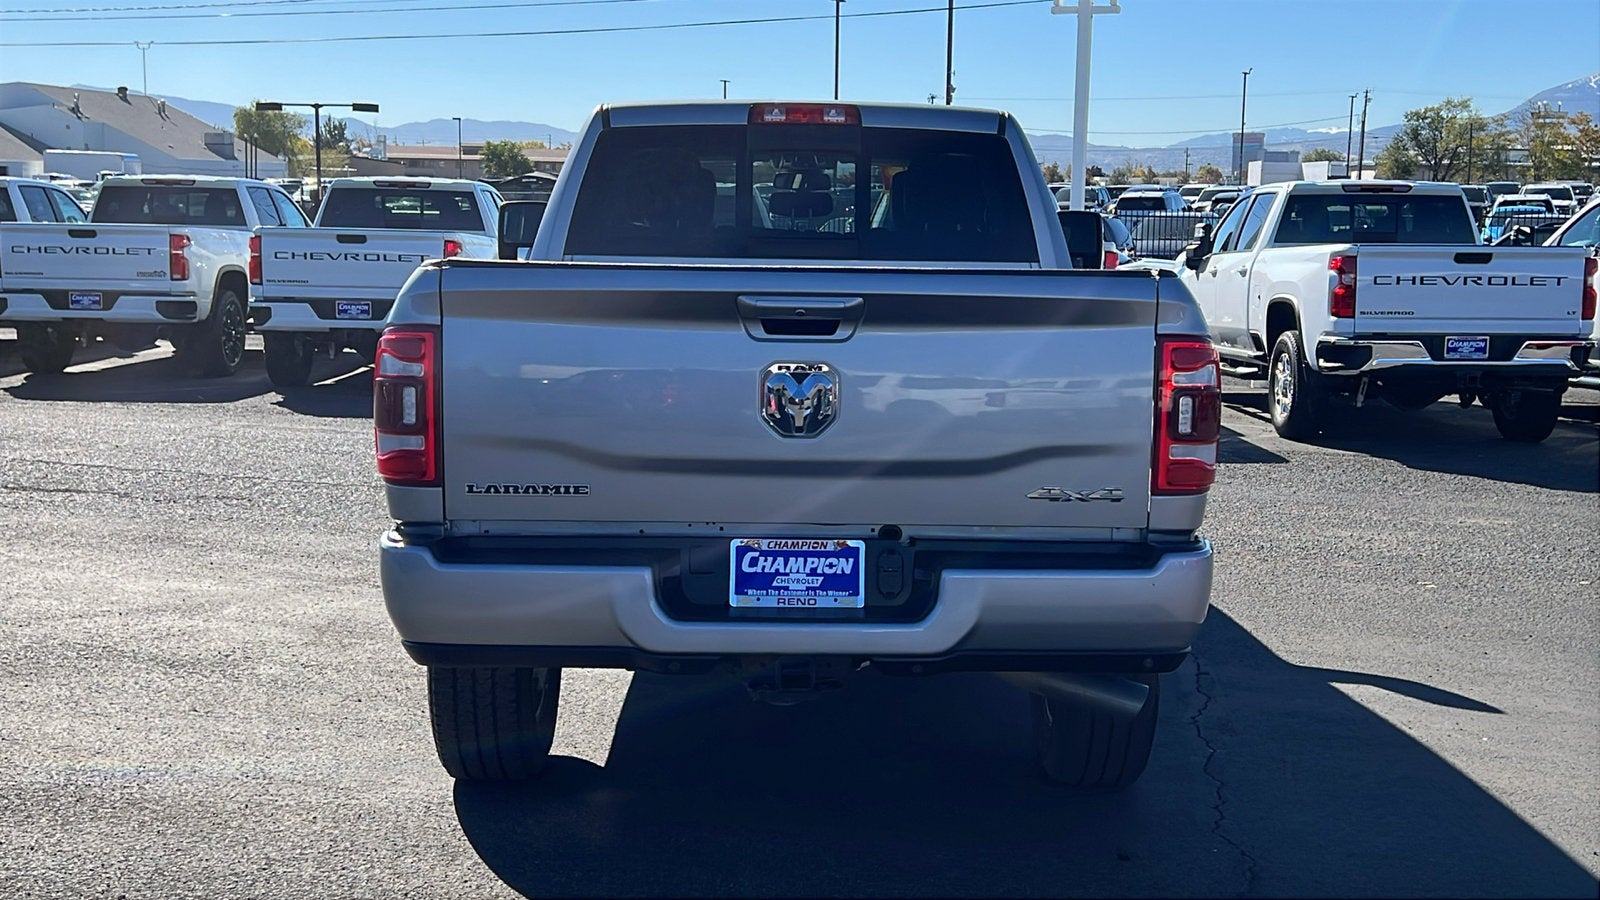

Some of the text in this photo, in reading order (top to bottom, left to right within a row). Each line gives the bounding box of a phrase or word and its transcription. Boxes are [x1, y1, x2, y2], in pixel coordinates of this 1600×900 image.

[11, 245, 157, 255] CHEVROLET
[274, 251, 430, 263] CHEVROLET
[1373, 275, 1568, 286] CHEVROLET
[1448, 339, 1486, 348] CHAMPION
[465, 483, 591, 496] LARAMIE
[767, 540, 828, 550] CHAMPION
[741, 551, 854, 574] CHAMPION
[775, 577, 820, 585] CHEVROLET
[768, 588, 779, 596] The
[780, 588, 808, 596] Customer
[777, 598, 817, 606] RENO
